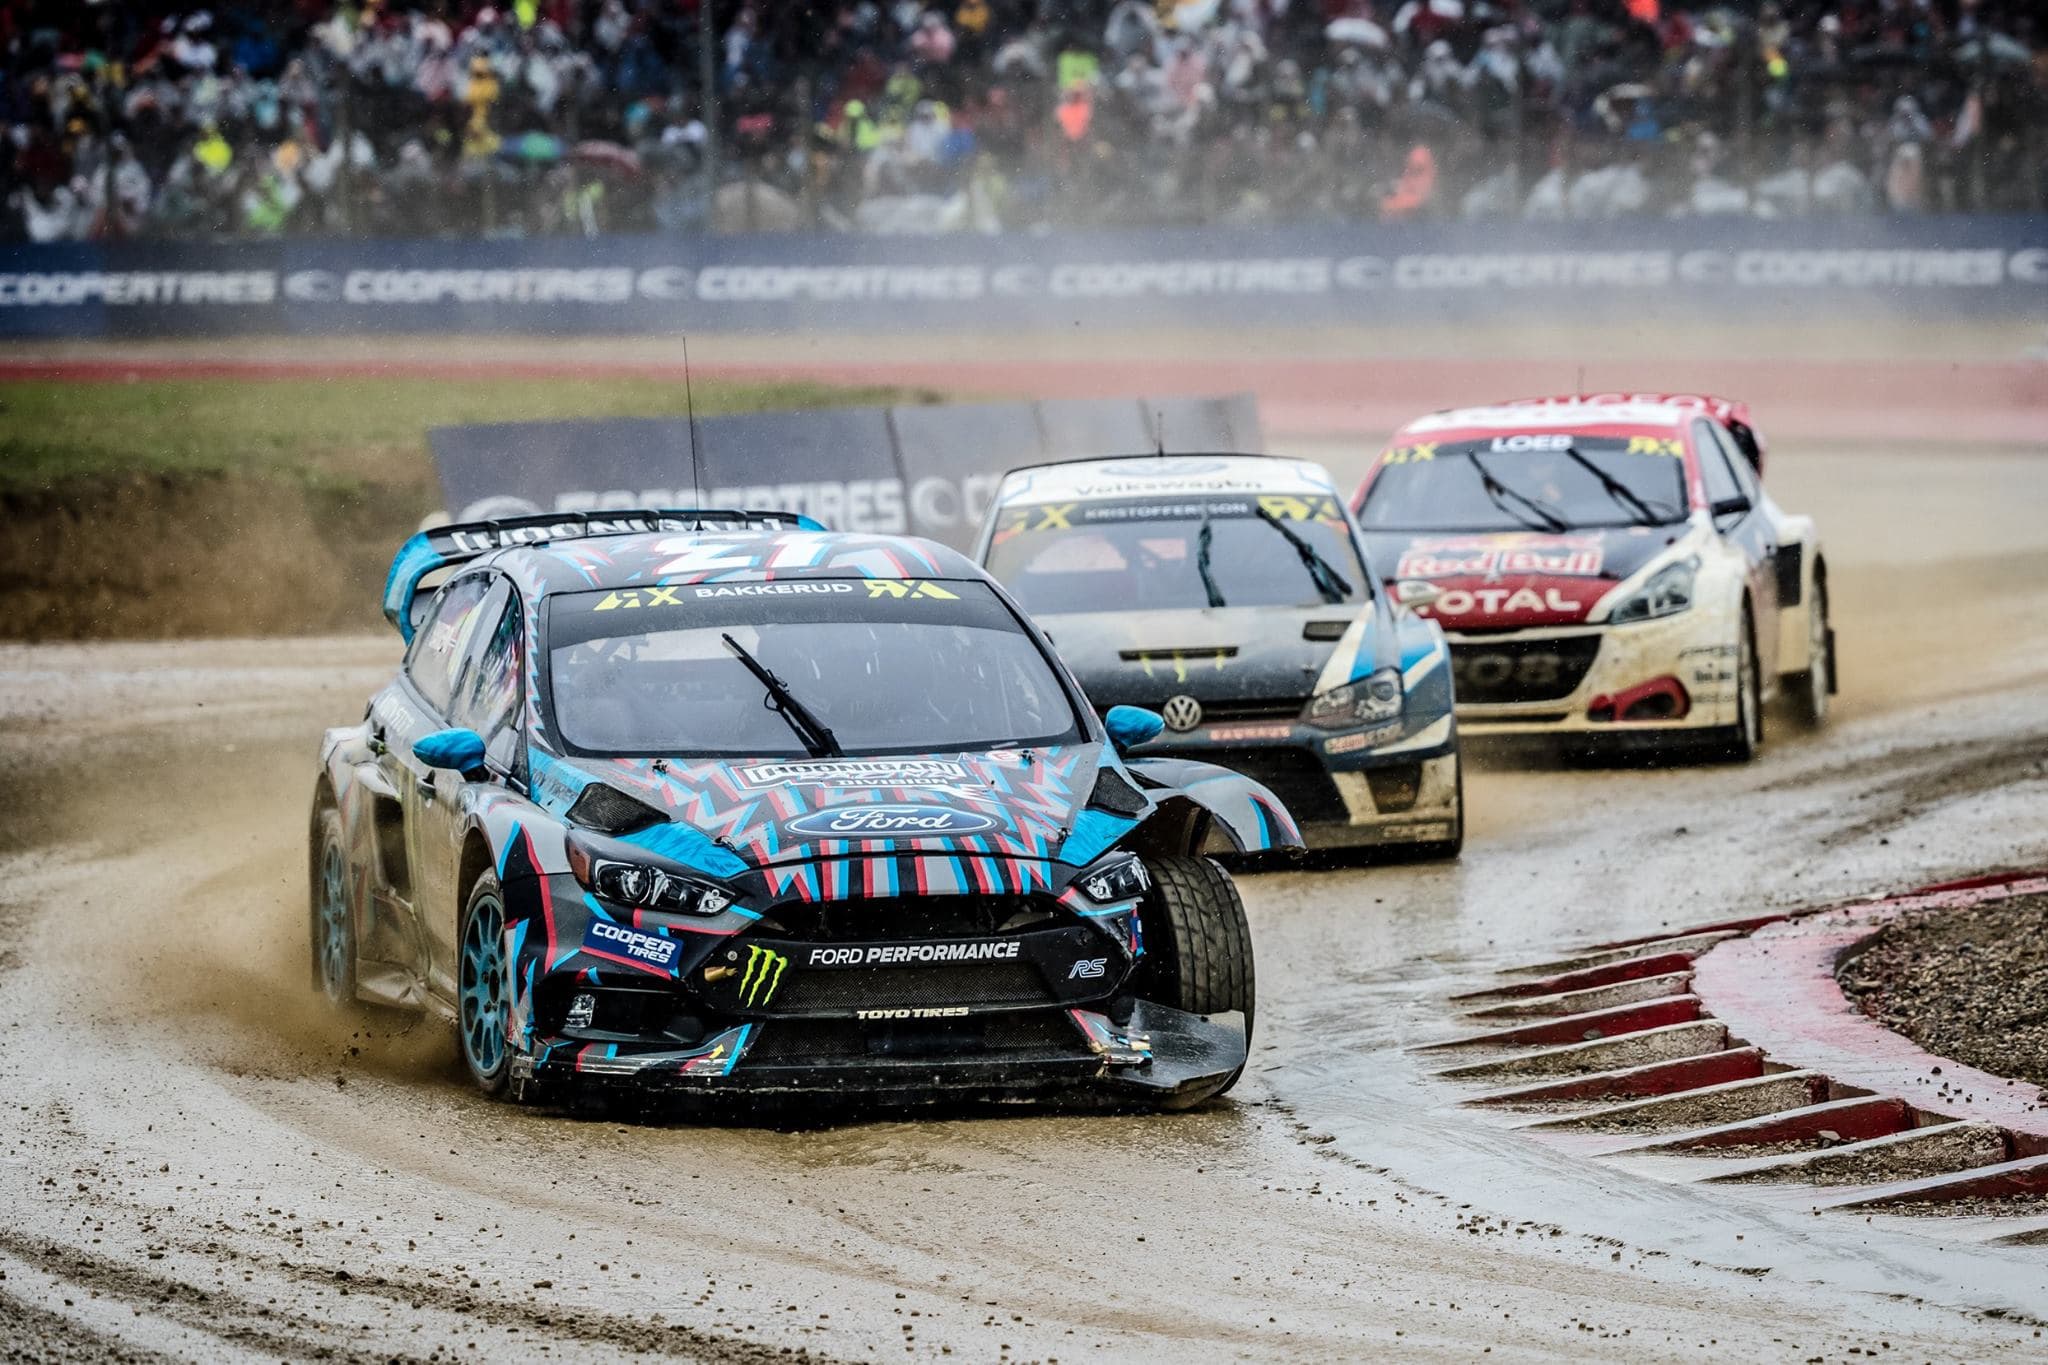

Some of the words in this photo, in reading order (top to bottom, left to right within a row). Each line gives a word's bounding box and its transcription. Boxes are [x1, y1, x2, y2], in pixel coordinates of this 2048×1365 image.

[695, 582, 854, 598] BAKKERUD
[830, 808, 953, 831] Ford
[592, 922, 676, 955] COOPER
[627, 944, 672, 964] TIRES
[809, 949, 863, 965] FORD
[865, 942, 1021, 964] PERFORMANCE
[1068, 958, 1108, 979] RS
[857, 1009, 910, 1020] TOYO
[911, 1007, 969, 1018] TIRES
